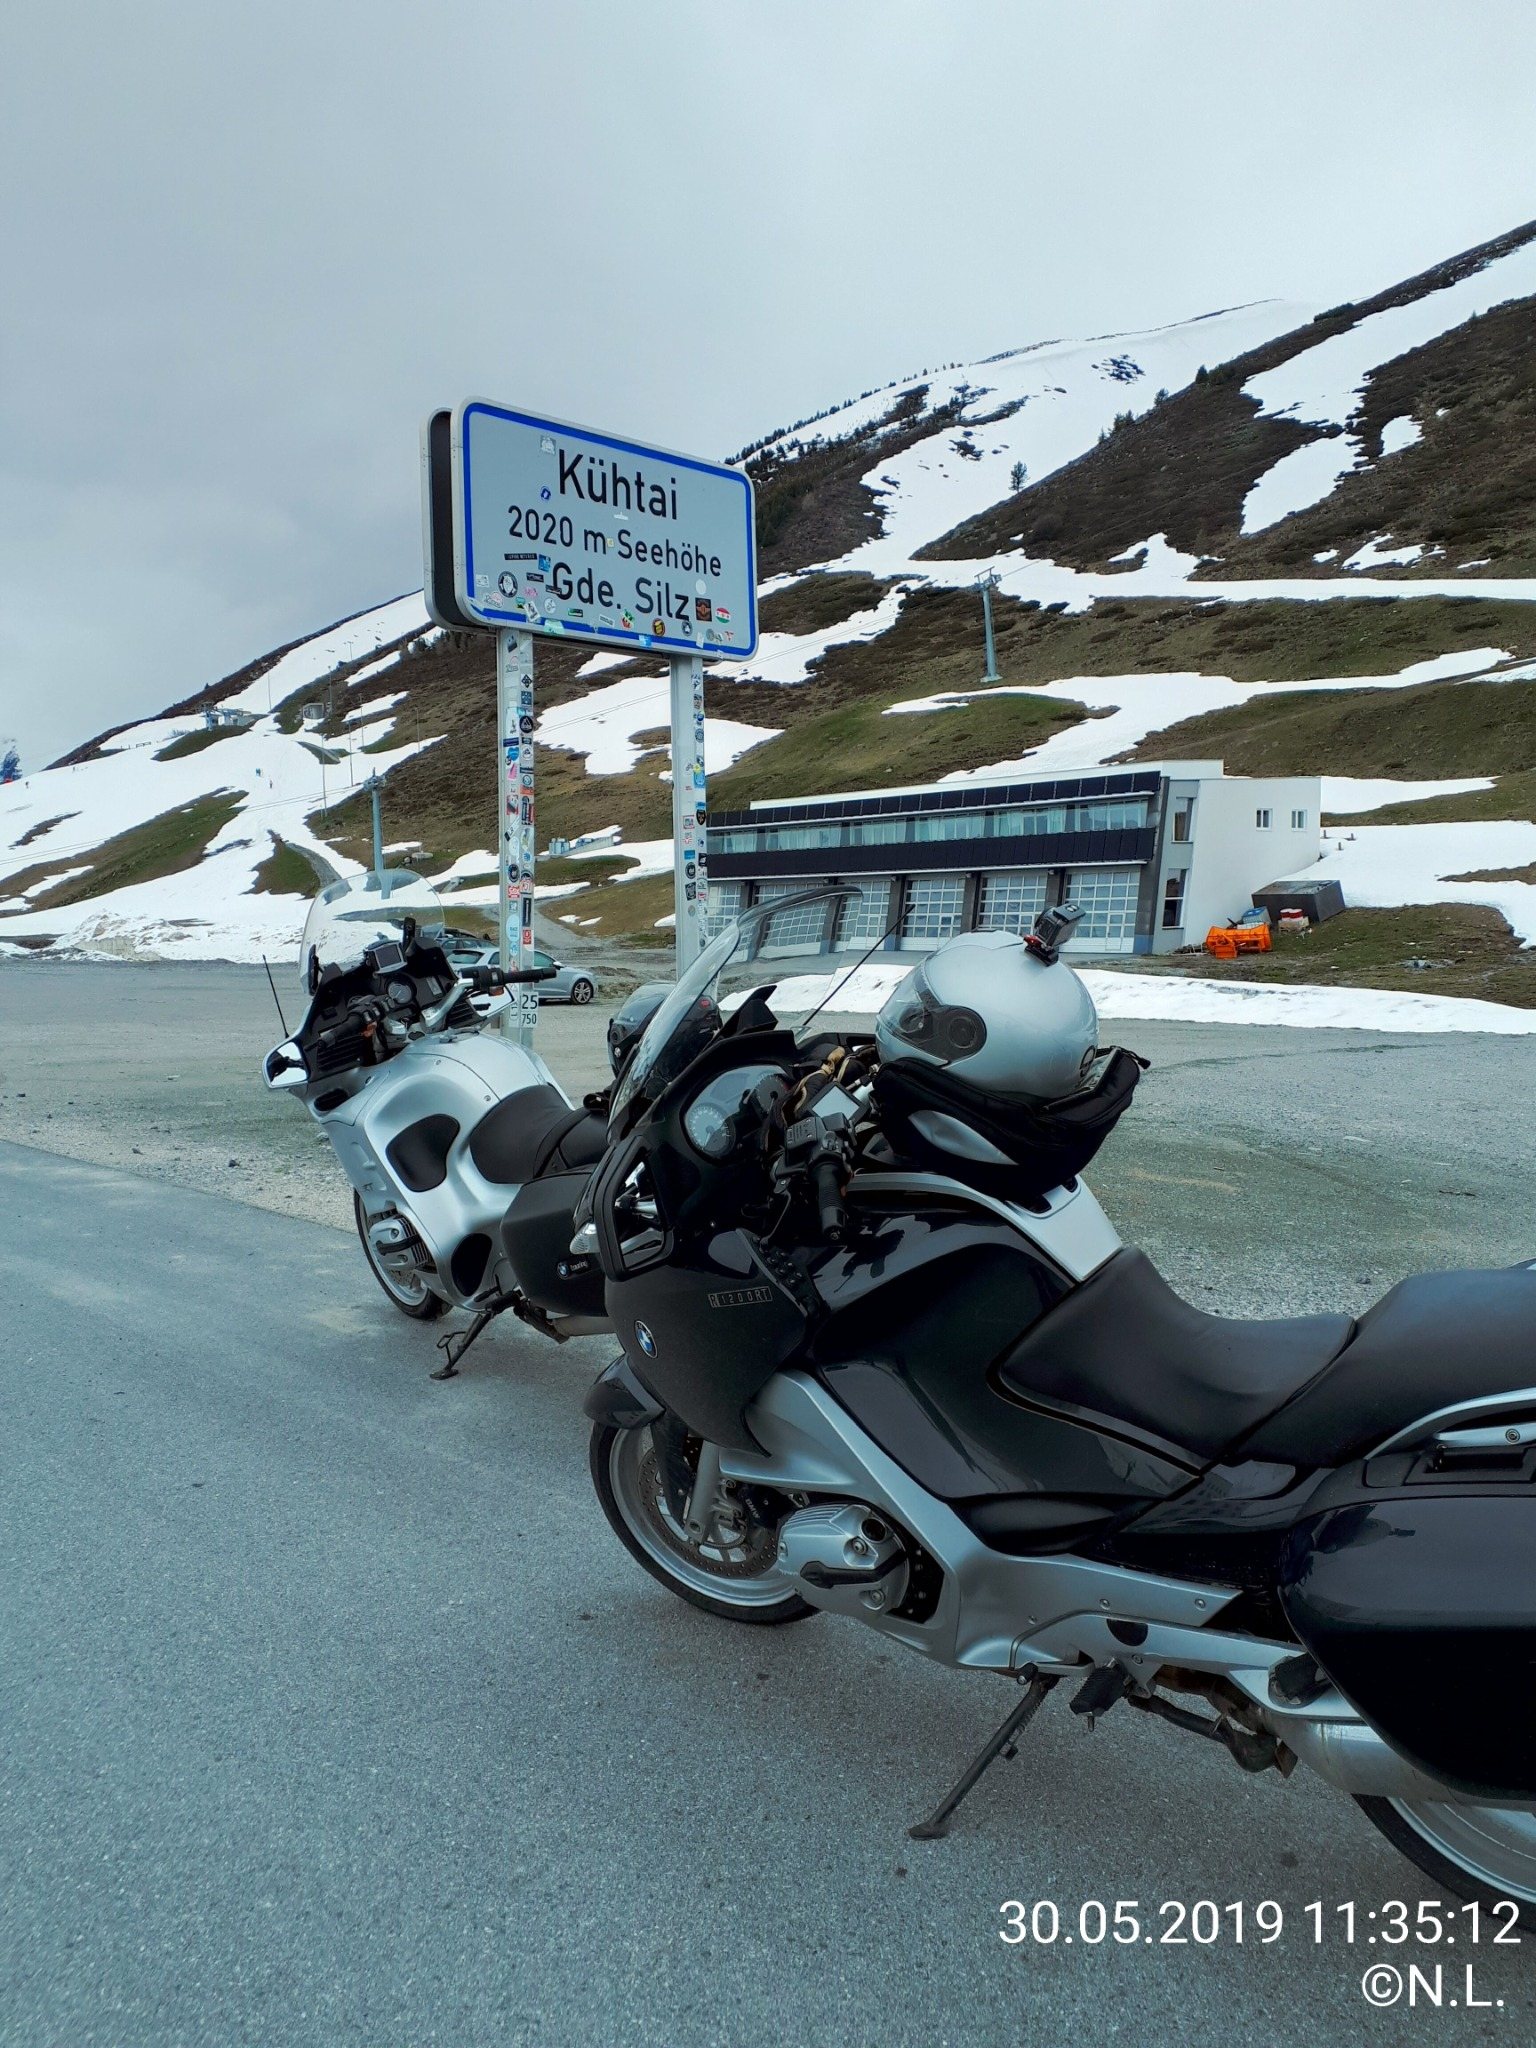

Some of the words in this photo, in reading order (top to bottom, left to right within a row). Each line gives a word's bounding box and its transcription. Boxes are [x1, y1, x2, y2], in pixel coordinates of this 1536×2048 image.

[559, 449, 677, 520] Kühtai
[508, 505, 573, 547] 2020
[584, 527, 607, 554] m
[617, 529, 721, 577] Seehöhe
[552, 562, 621, 610] Gde.
[635, 577, 690, 620] Silz
[521, 994, 538, 1010] 25
[521, 1013, 537, 1026] 750
